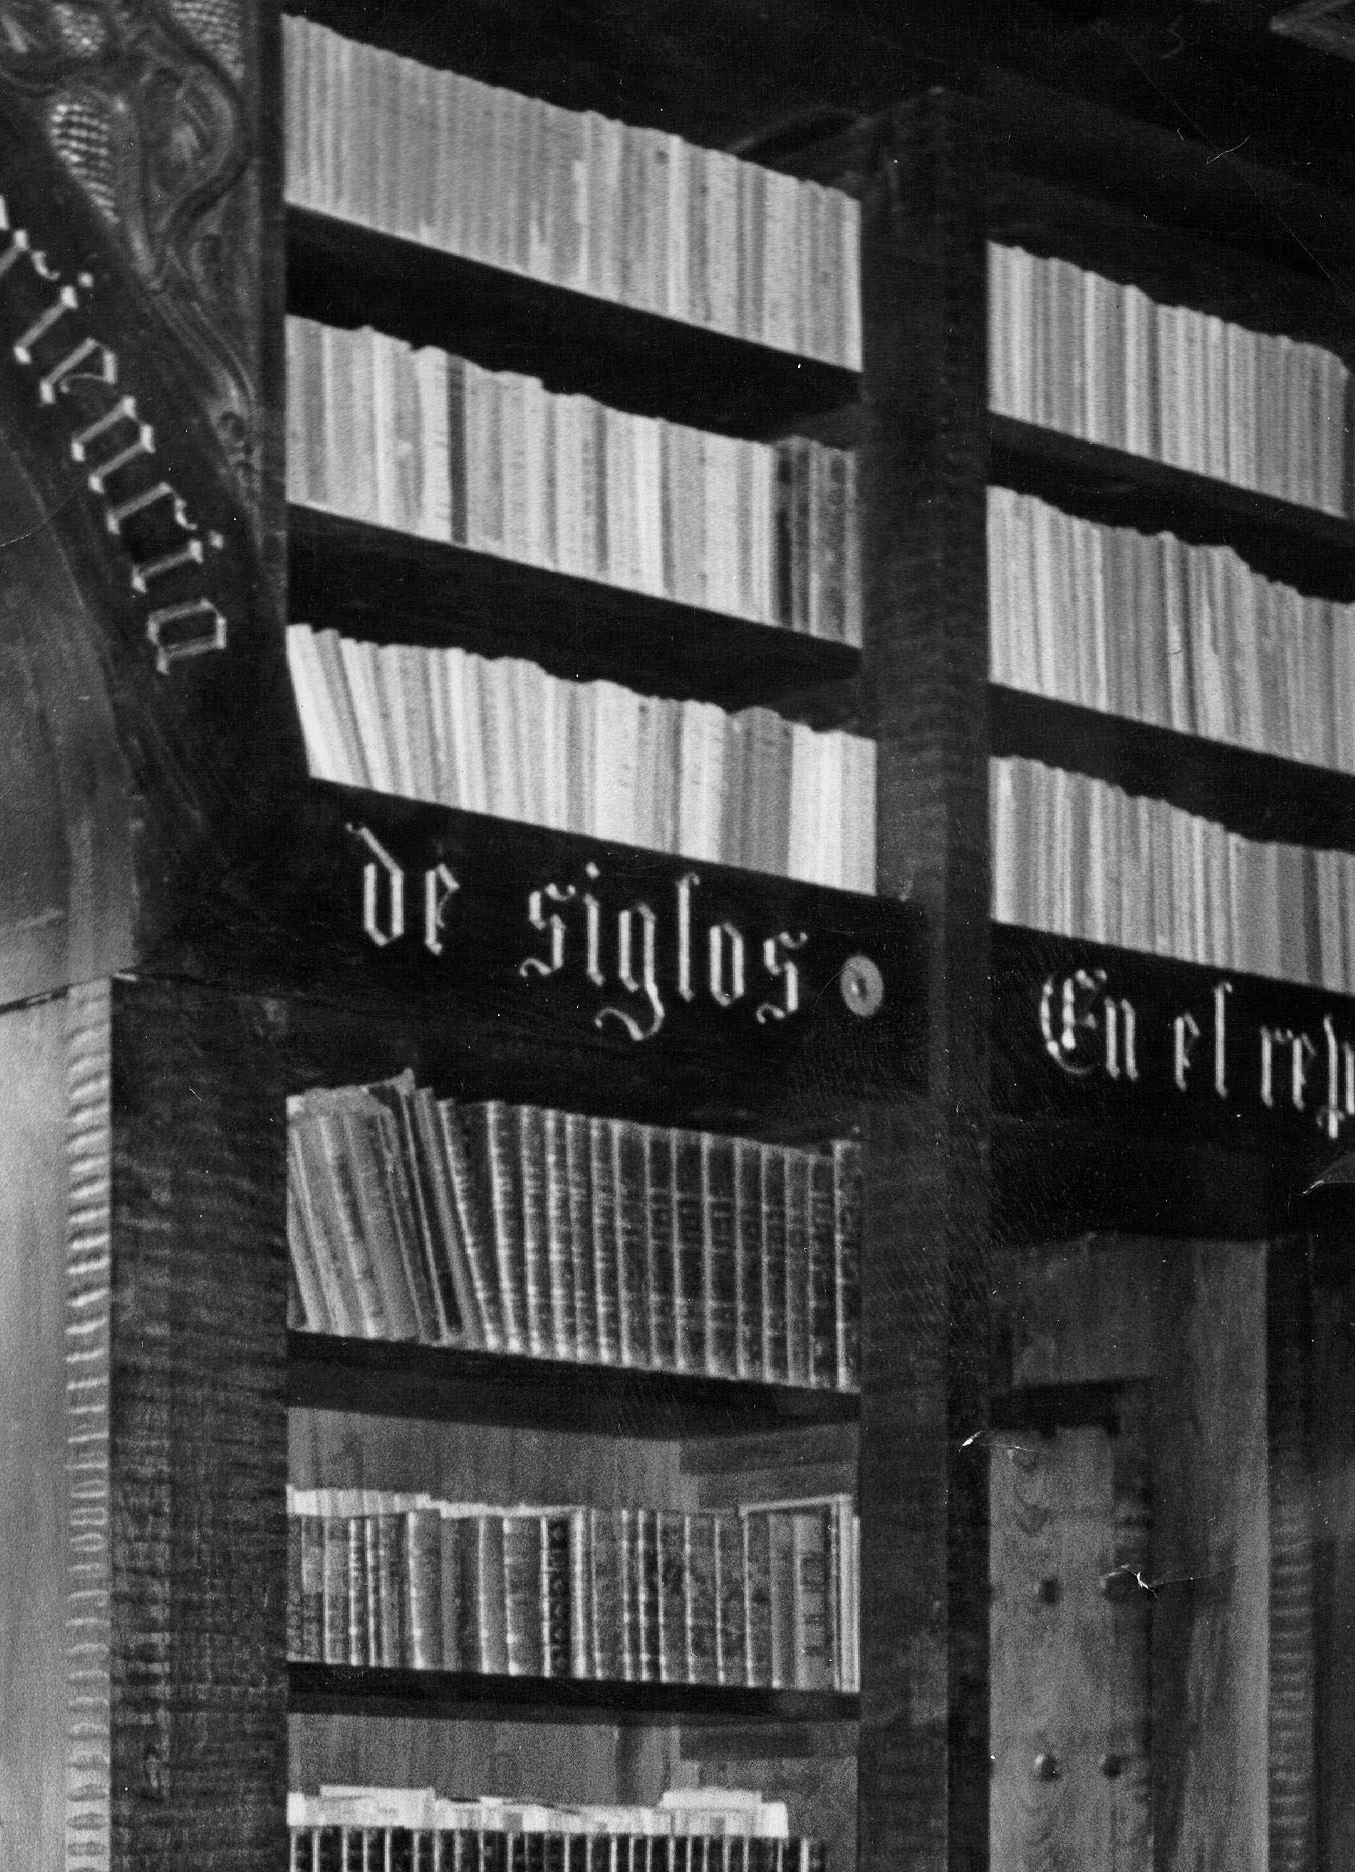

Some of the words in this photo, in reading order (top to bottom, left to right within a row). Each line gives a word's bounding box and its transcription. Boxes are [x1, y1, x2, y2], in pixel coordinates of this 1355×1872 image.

[520, 862, 809, 1042] siglos
[1039, 969, 1139, 1081] En
[1174, 982, 1233, 1098] el
